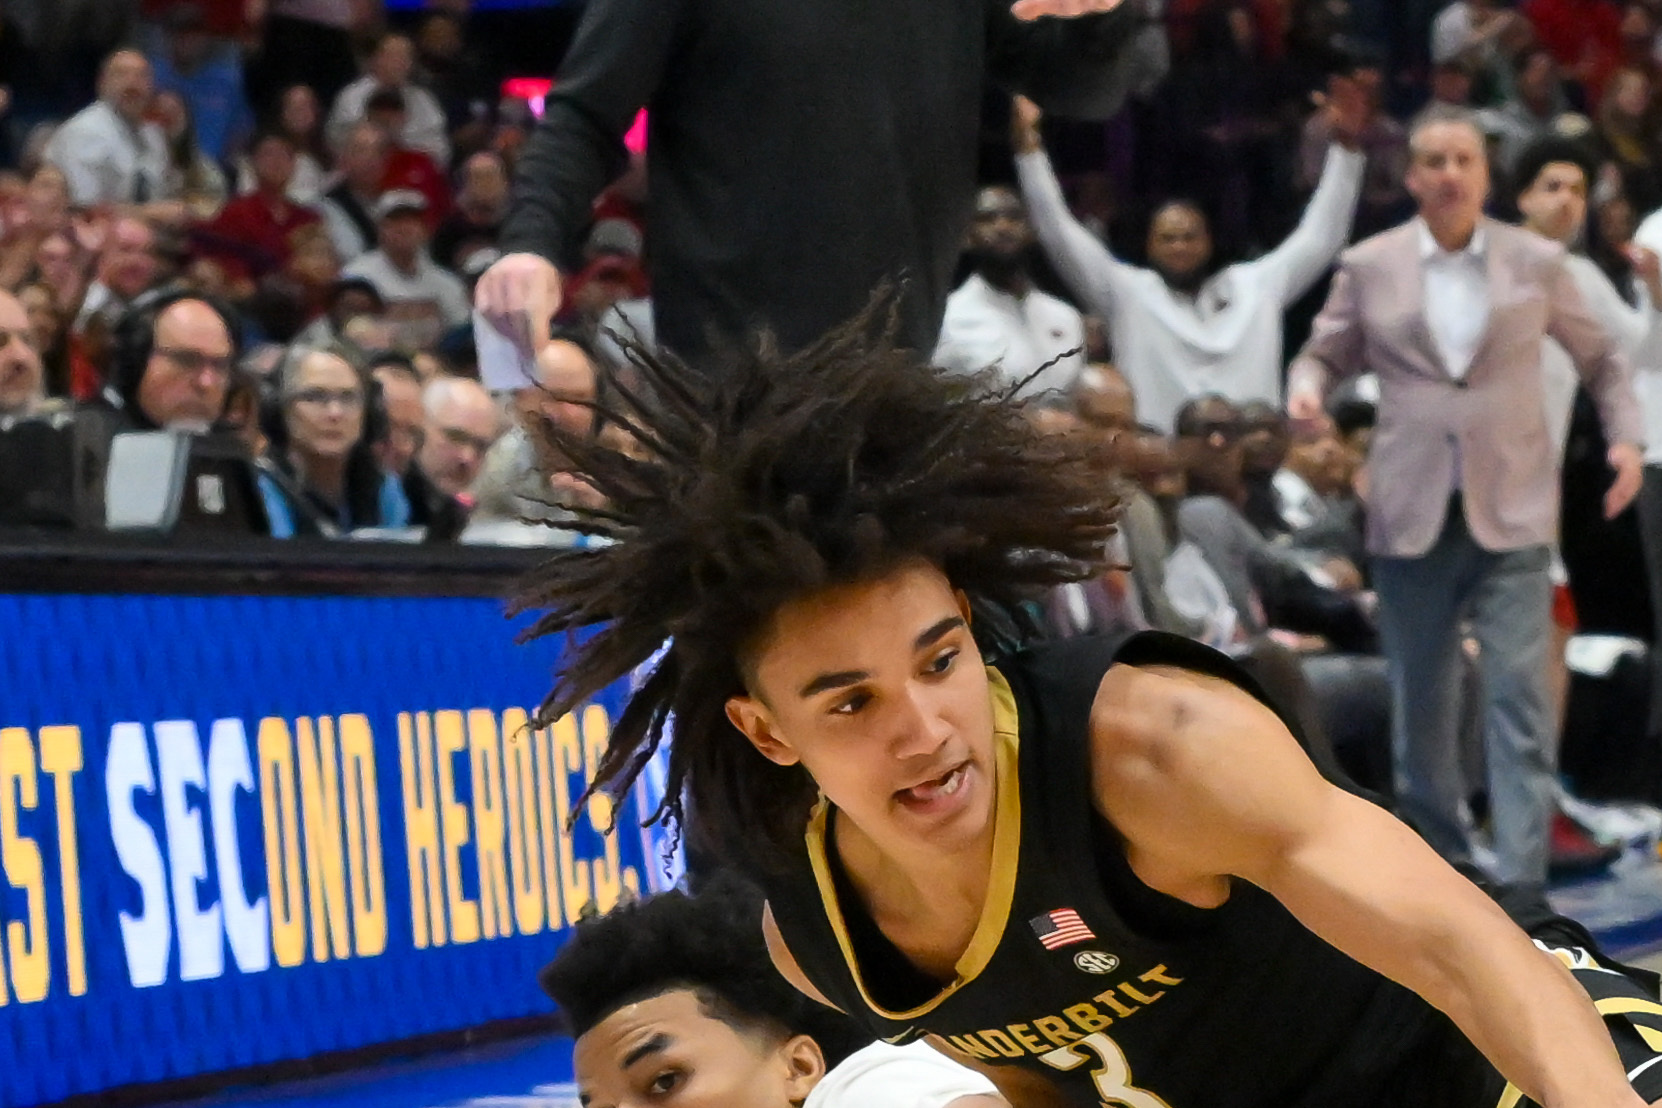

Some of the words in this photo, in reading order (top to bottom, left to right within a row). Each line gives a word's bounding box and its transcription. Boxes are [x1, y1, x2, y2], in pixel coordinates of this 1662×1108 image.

[0, 724, 88, 1007] ST
[105, 712, 388, 989] SECOND
[1078, 951, 1117, 973] SEC
